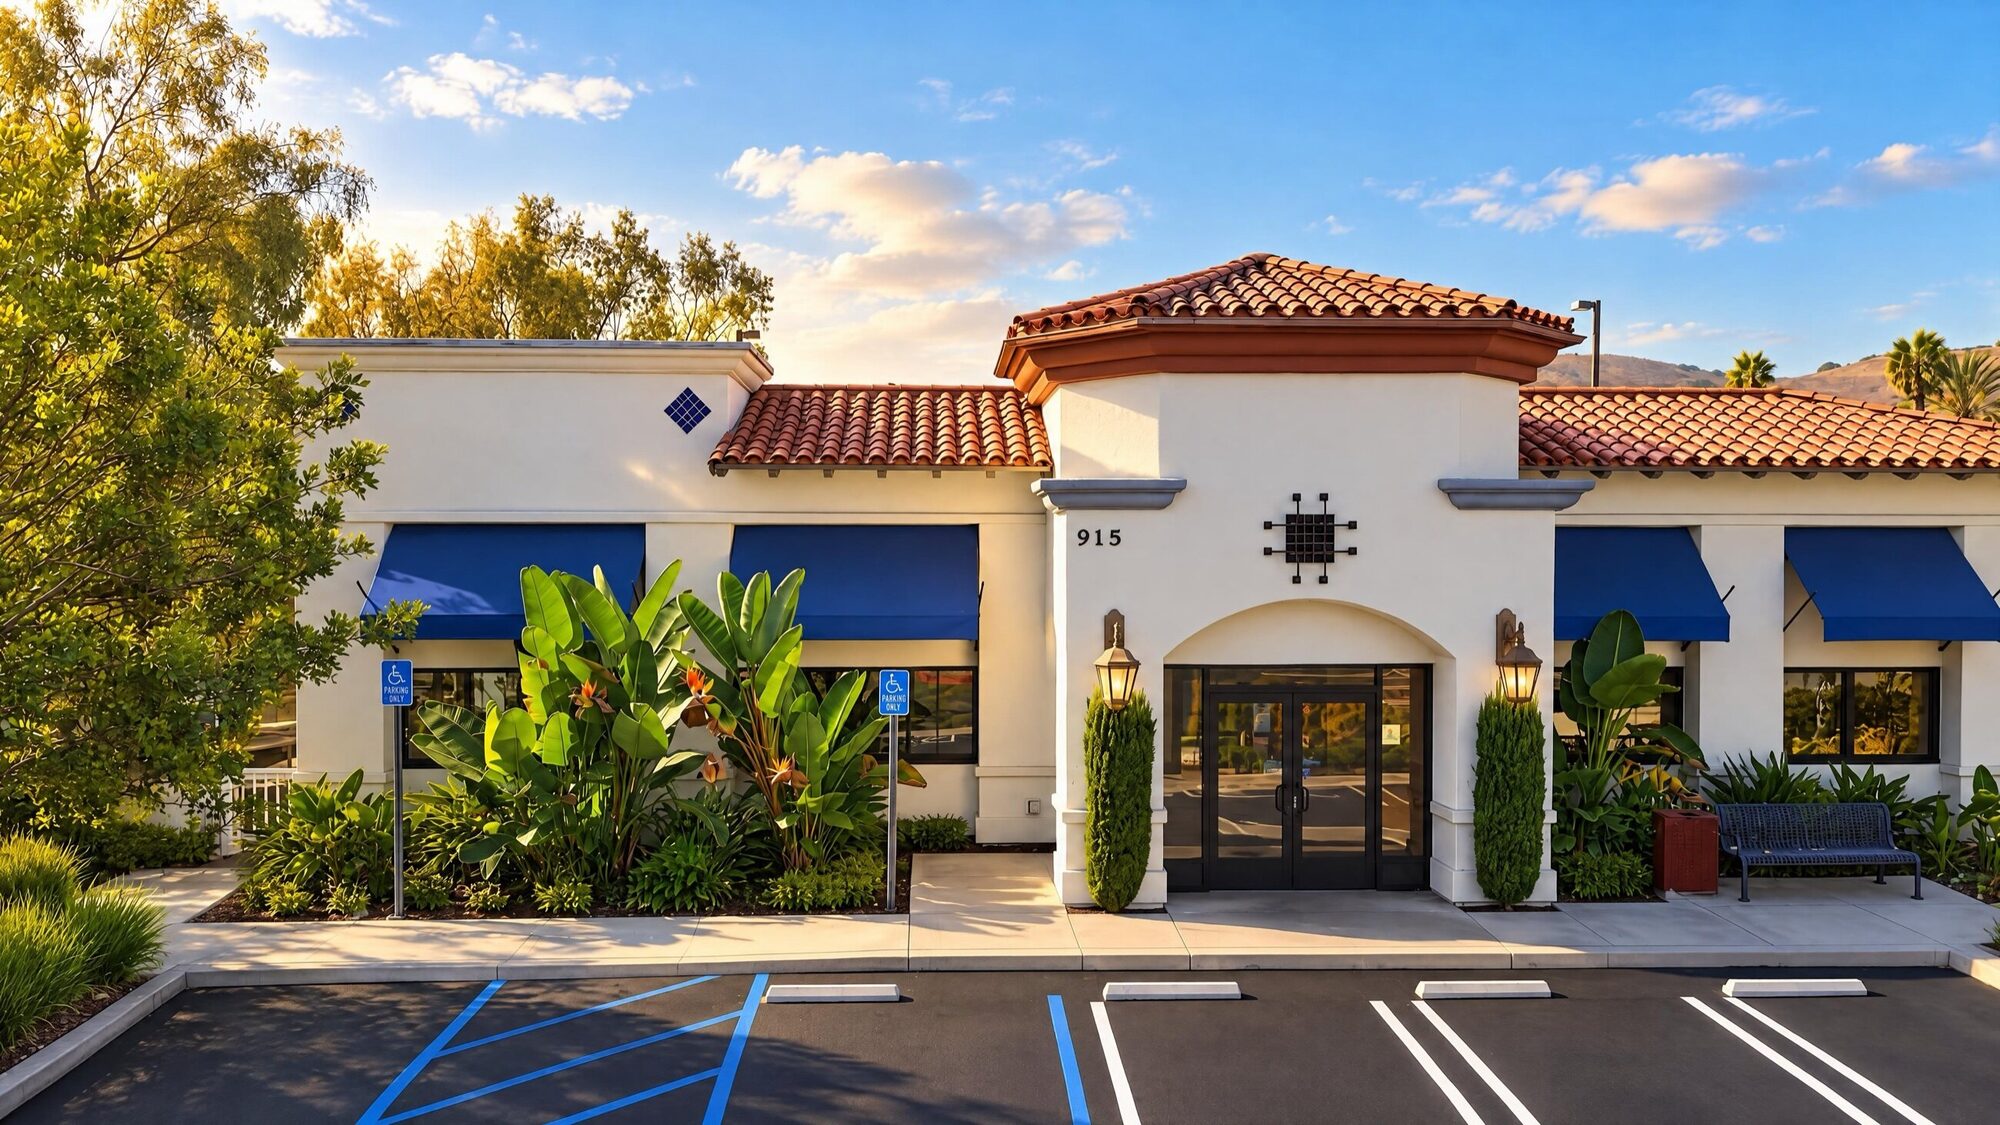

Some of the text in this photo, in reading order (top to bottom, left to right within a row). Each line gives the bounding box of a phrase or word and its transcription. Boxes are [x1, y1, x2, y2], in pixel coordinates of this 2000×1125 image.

[1077, 529, 1121, 547] 915
[384, 686, 409, 695] PARKING
[389, 695, 404, 703] ONLY
[882, 694, 906, 703] PARKING
[886, 703, 901, 711] ONLY
